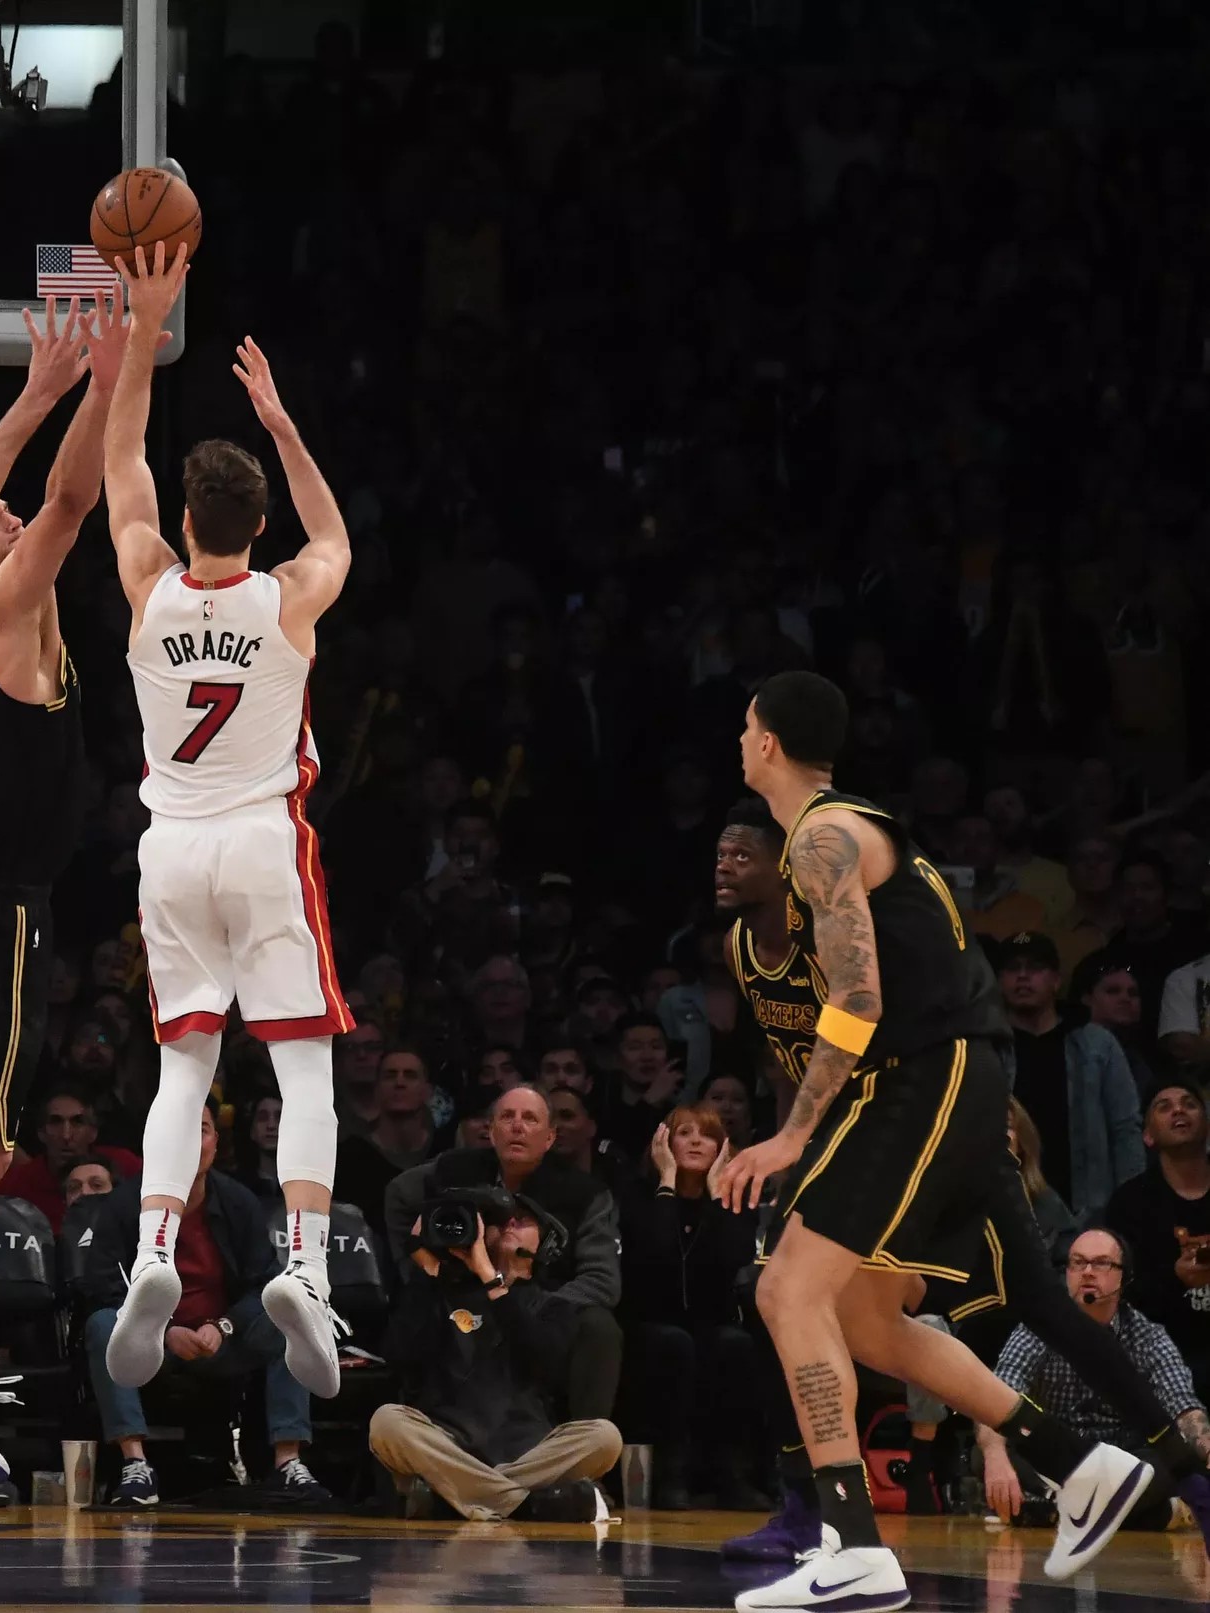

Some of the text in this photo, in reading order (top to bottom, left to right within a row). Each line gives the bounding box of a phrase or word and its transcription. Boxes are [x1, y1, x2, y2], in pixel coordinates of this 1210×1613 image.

[162, 630, 263, 668] DRAGIĆ
[171, 681, 245, 764] 7
[750, 989, 816, 1035] LAKERS
